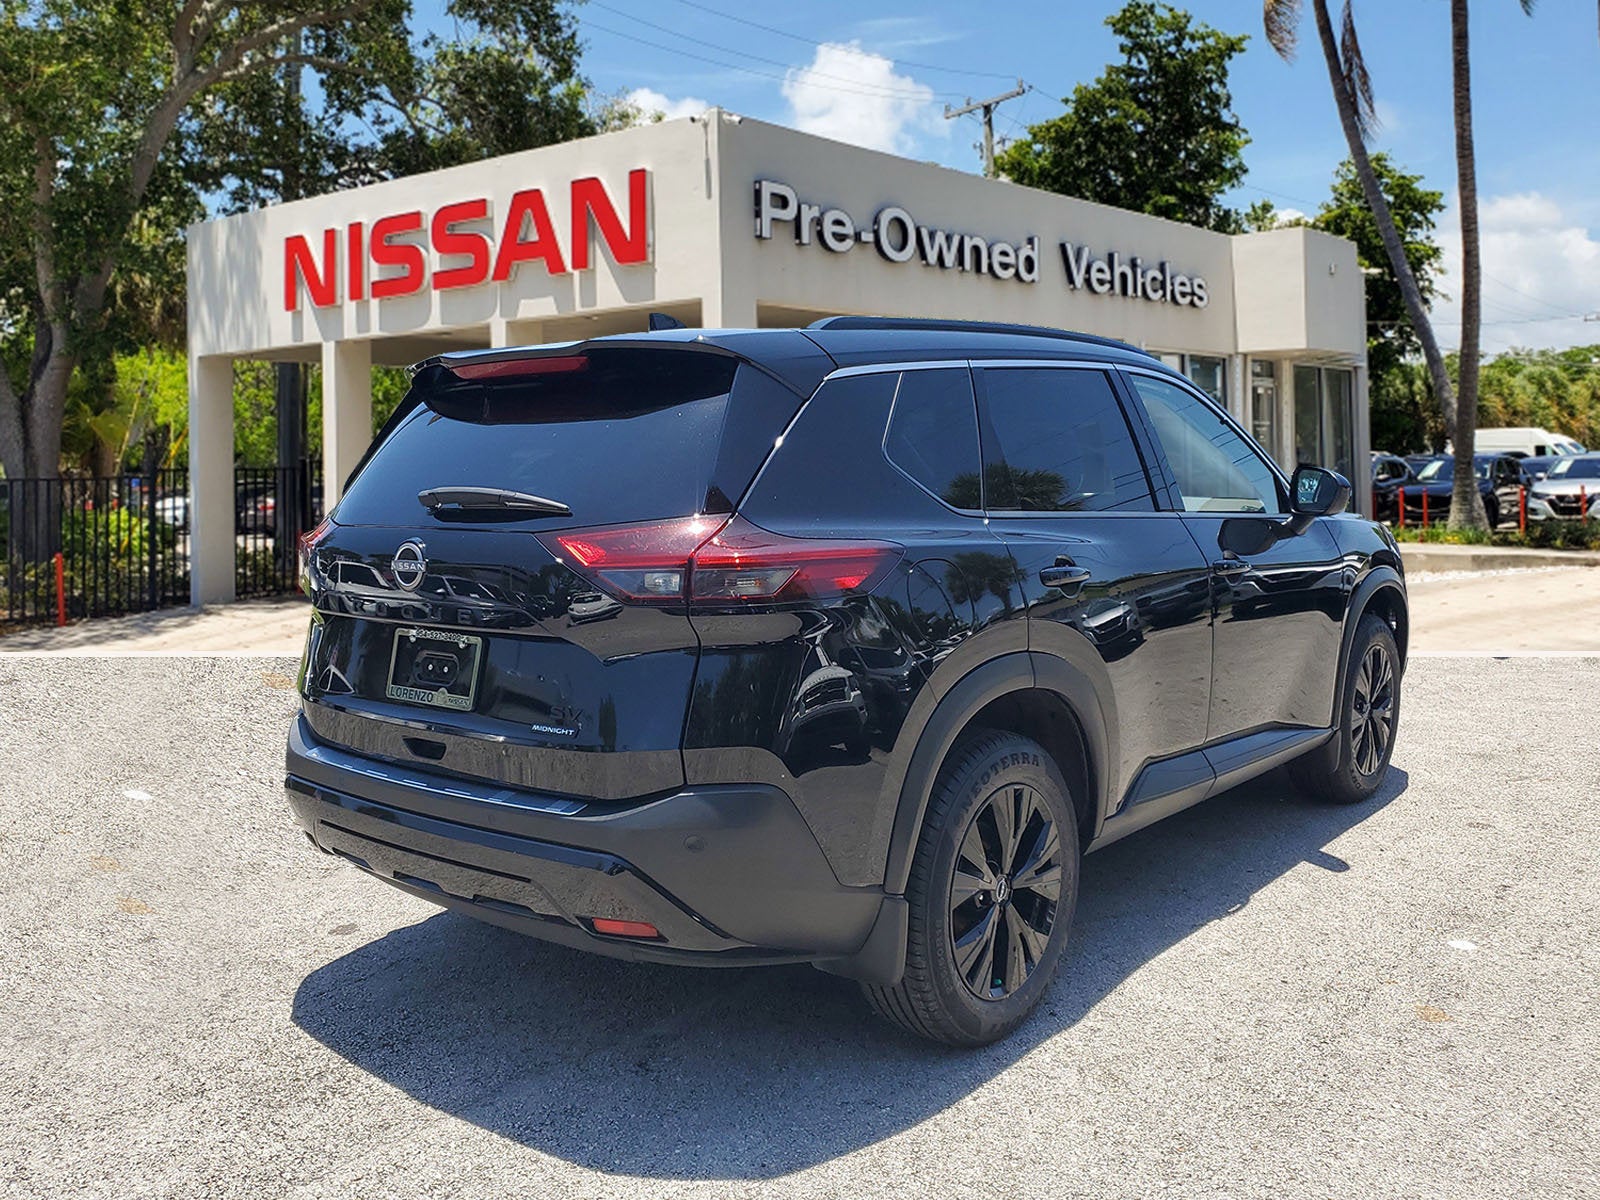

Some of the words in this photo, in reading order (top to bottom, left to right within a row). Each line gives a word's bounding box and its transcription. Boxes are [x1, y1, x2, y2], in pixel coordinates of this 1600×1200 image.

[285, 168, 648, 311] NISSAN
[754, 180, 1040, 283] Pre-Owned
[1061, 242, 1209, 308] Vehicles
[391, 561, 425, 572] NISSAN
[353, 599, 473, 625] ROGUE
[391, 686, 434, 703] LORENZO
[531, 724, 575, 737] MIDNIGHT
